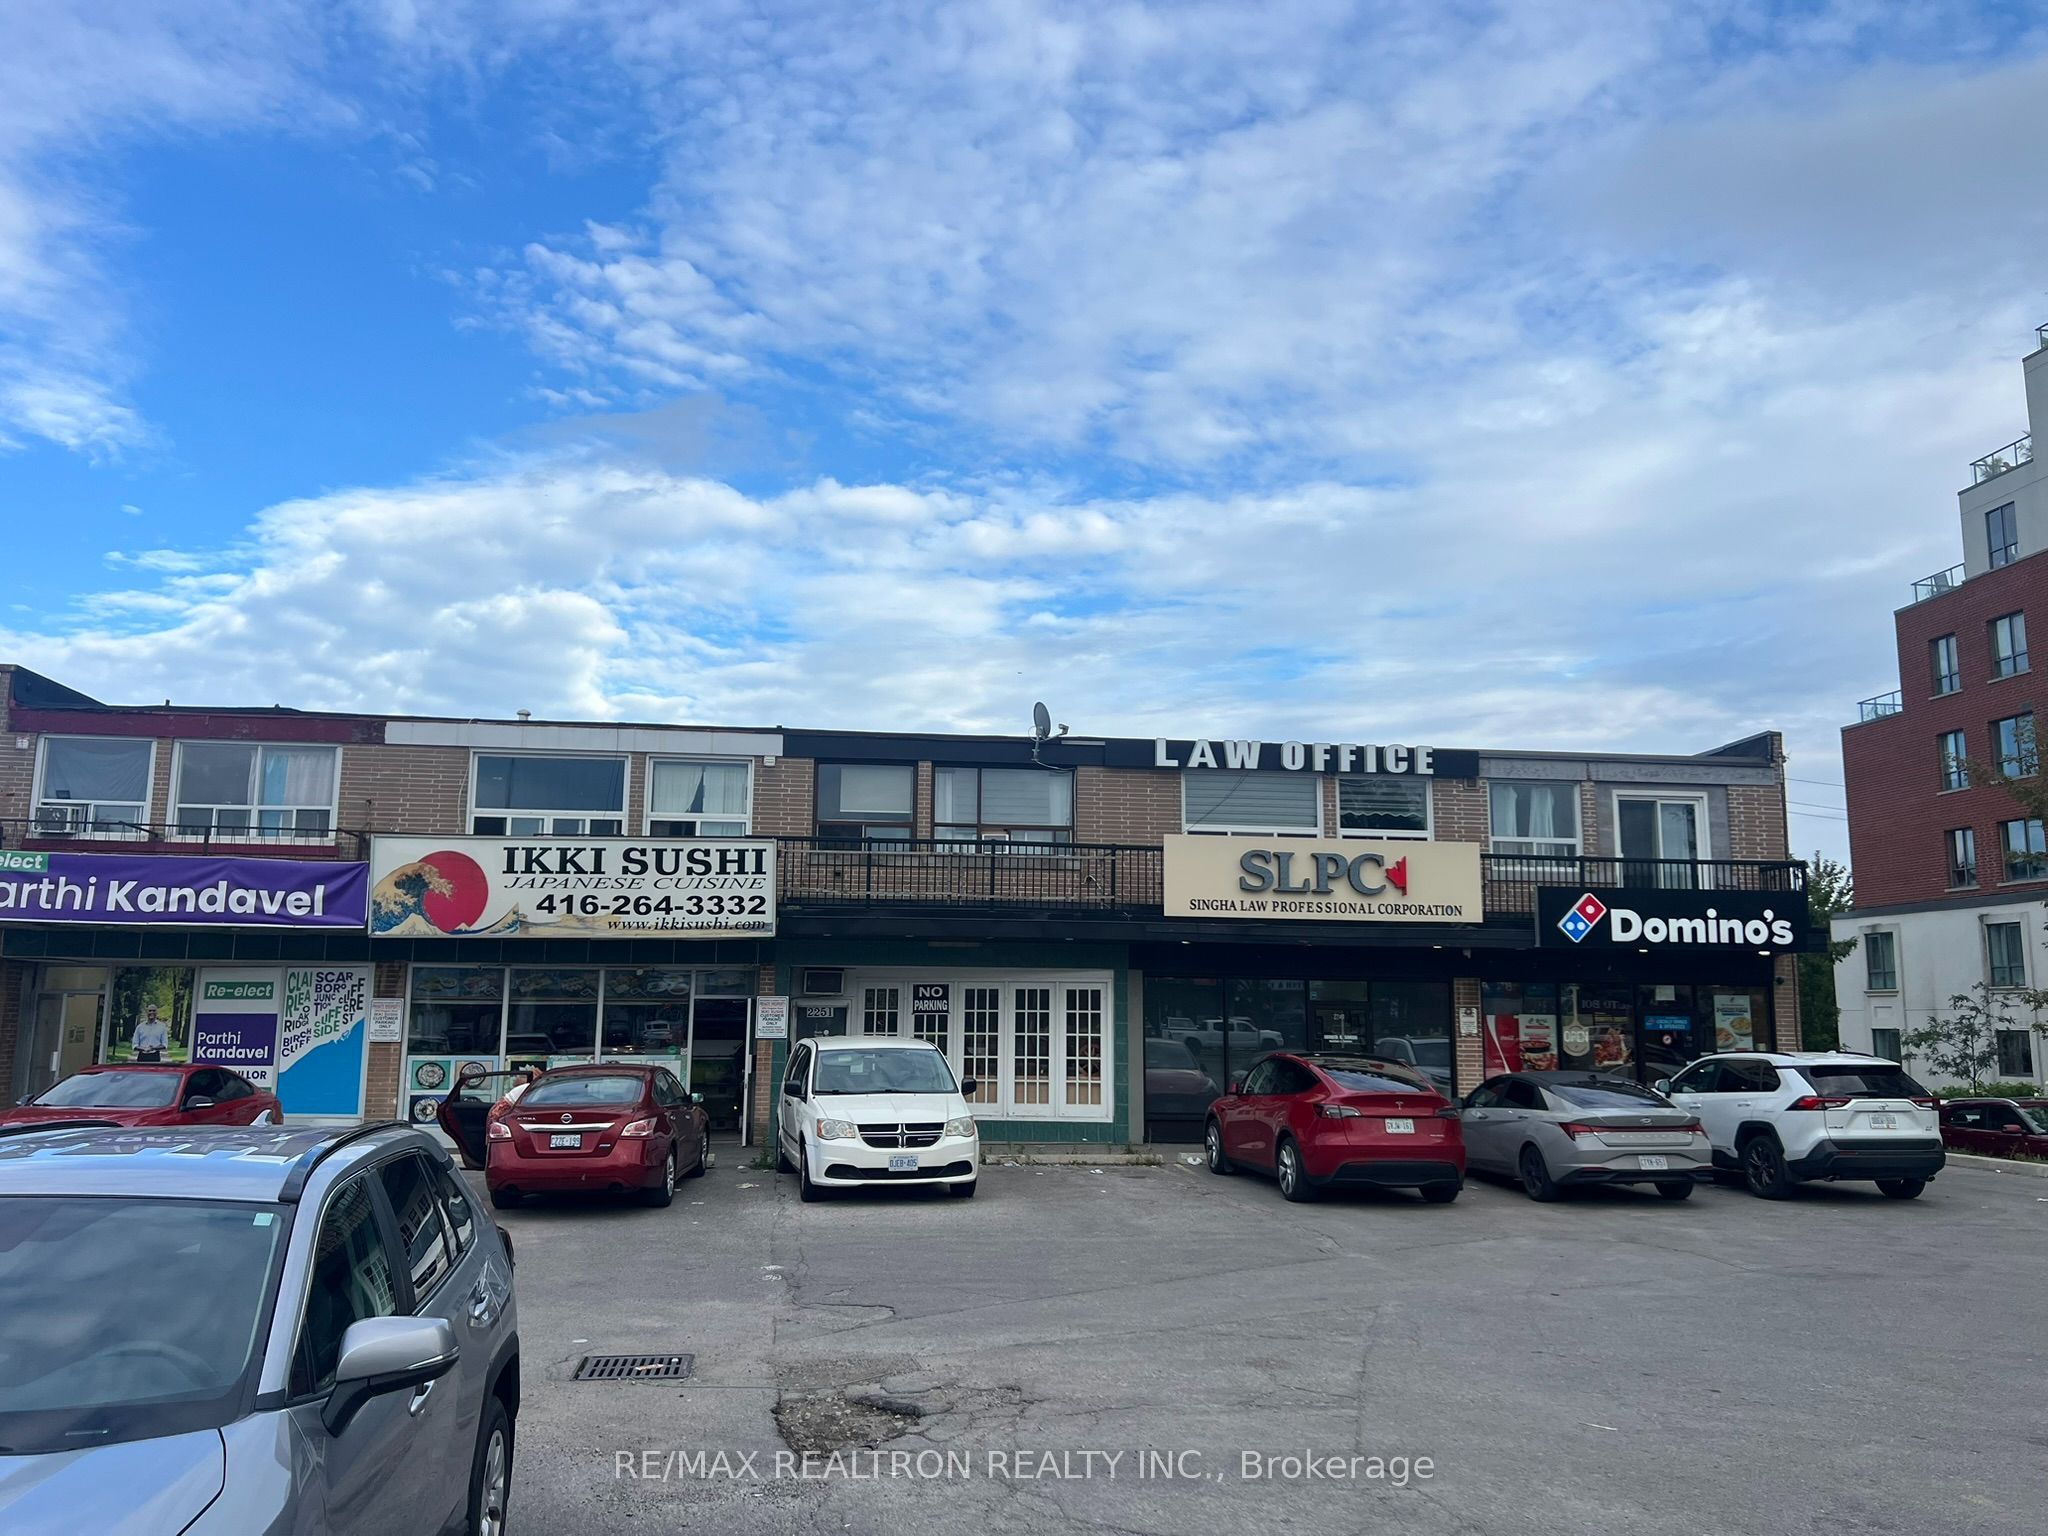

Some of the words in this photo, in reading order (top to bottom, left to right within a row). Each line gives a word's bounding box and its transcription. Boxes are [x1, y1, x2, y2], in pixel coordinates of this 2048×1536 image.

[1154, 738, 1262, 770] LAW
[1280, 740, 1434, 775] OFFICE
[502, 847, 607, 874] IKKI
[621, 847, 767, 876] SUSHI
[1239, 849, 1387, 896] SLPC
[503, 876, 646, 890] JAPANESE
[653, 877, 767, 890] CUISINE
[105, 880, 325, 917] Kandavel
[536, 894, 767, 916] 416-264-3332
[1189, 898, 1238, 912] SINGHA
[1239, 900, 1268, 912] LAW
[1272, 901, 1375, 915] PROFESSIONAL
[1377, 903, 1463, 917] CORPORATION
[607, 917, 766, 931] www.ikkisushi.com
[1609, 908, 1794, 946] Domino's
[315, 971, 354, 983] SCAR
[207, 984, 272, 997] Re-elect
[919, 986, 943, 997] NO
[913, 999, 948, 1011] PARKING
[807, 1008, 833, 1017] 2251
[197, 1031, 241, 1045] Parthi
[1563, 1030, 1590, 1043] OPEN
[196, 1045, 269, 1059] Kandavel
